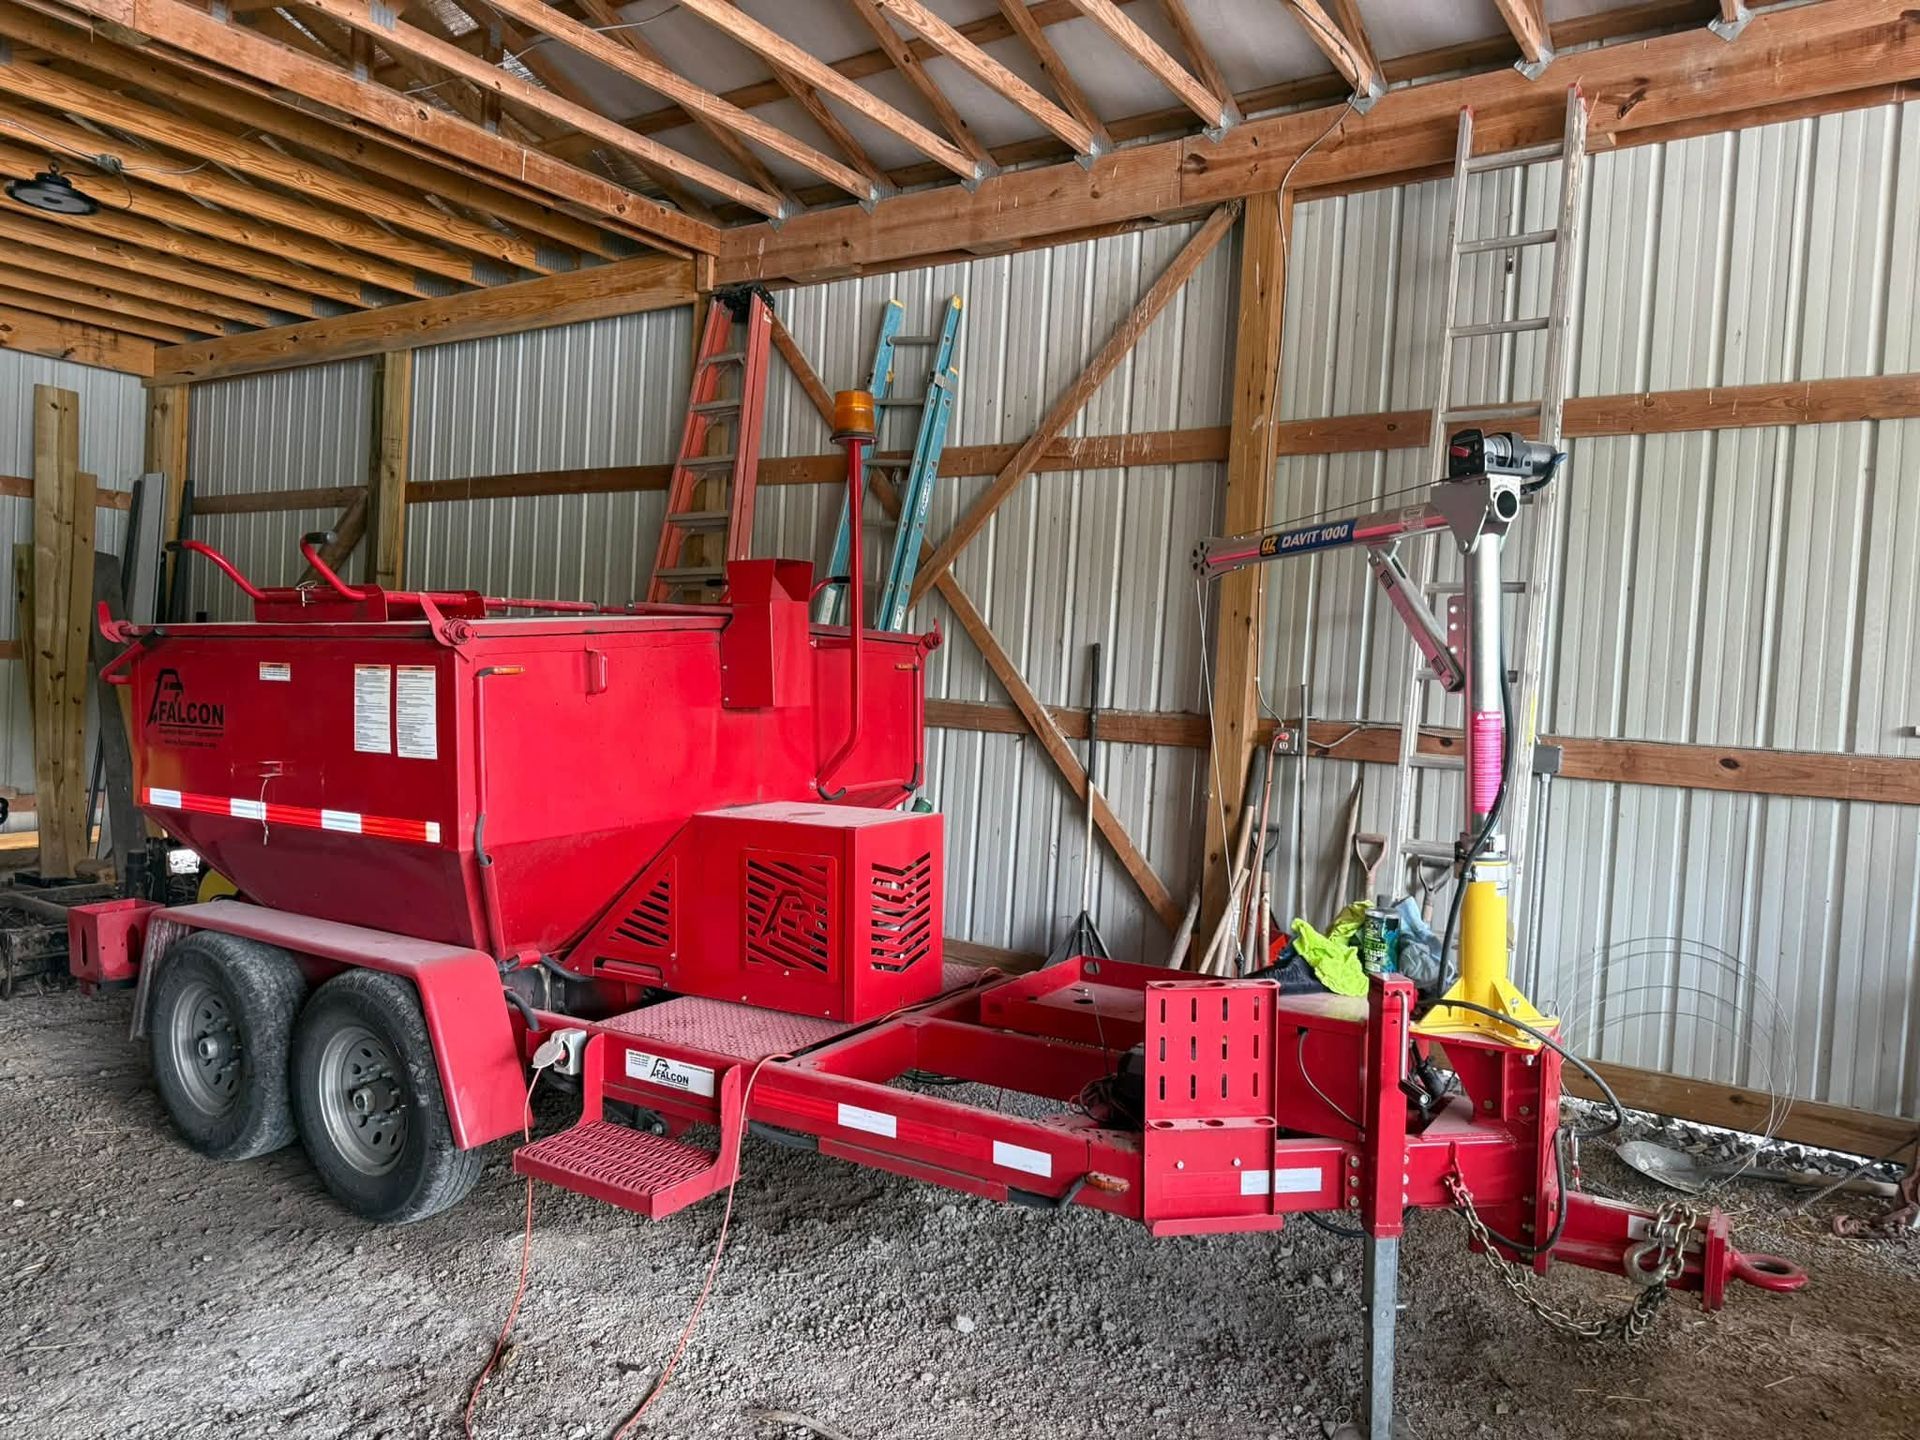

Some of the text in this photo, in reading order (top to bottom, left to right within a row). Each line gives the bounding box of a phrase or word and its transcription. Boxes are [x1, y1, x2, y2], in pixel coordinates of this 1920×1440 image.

[1281, 530, 1320, 548] DAVIT
[1321, 525, 1349, 541] 1000
[158, 701, 224, 726] FALCON
[656, 1070, 689, 1085] FALCON
